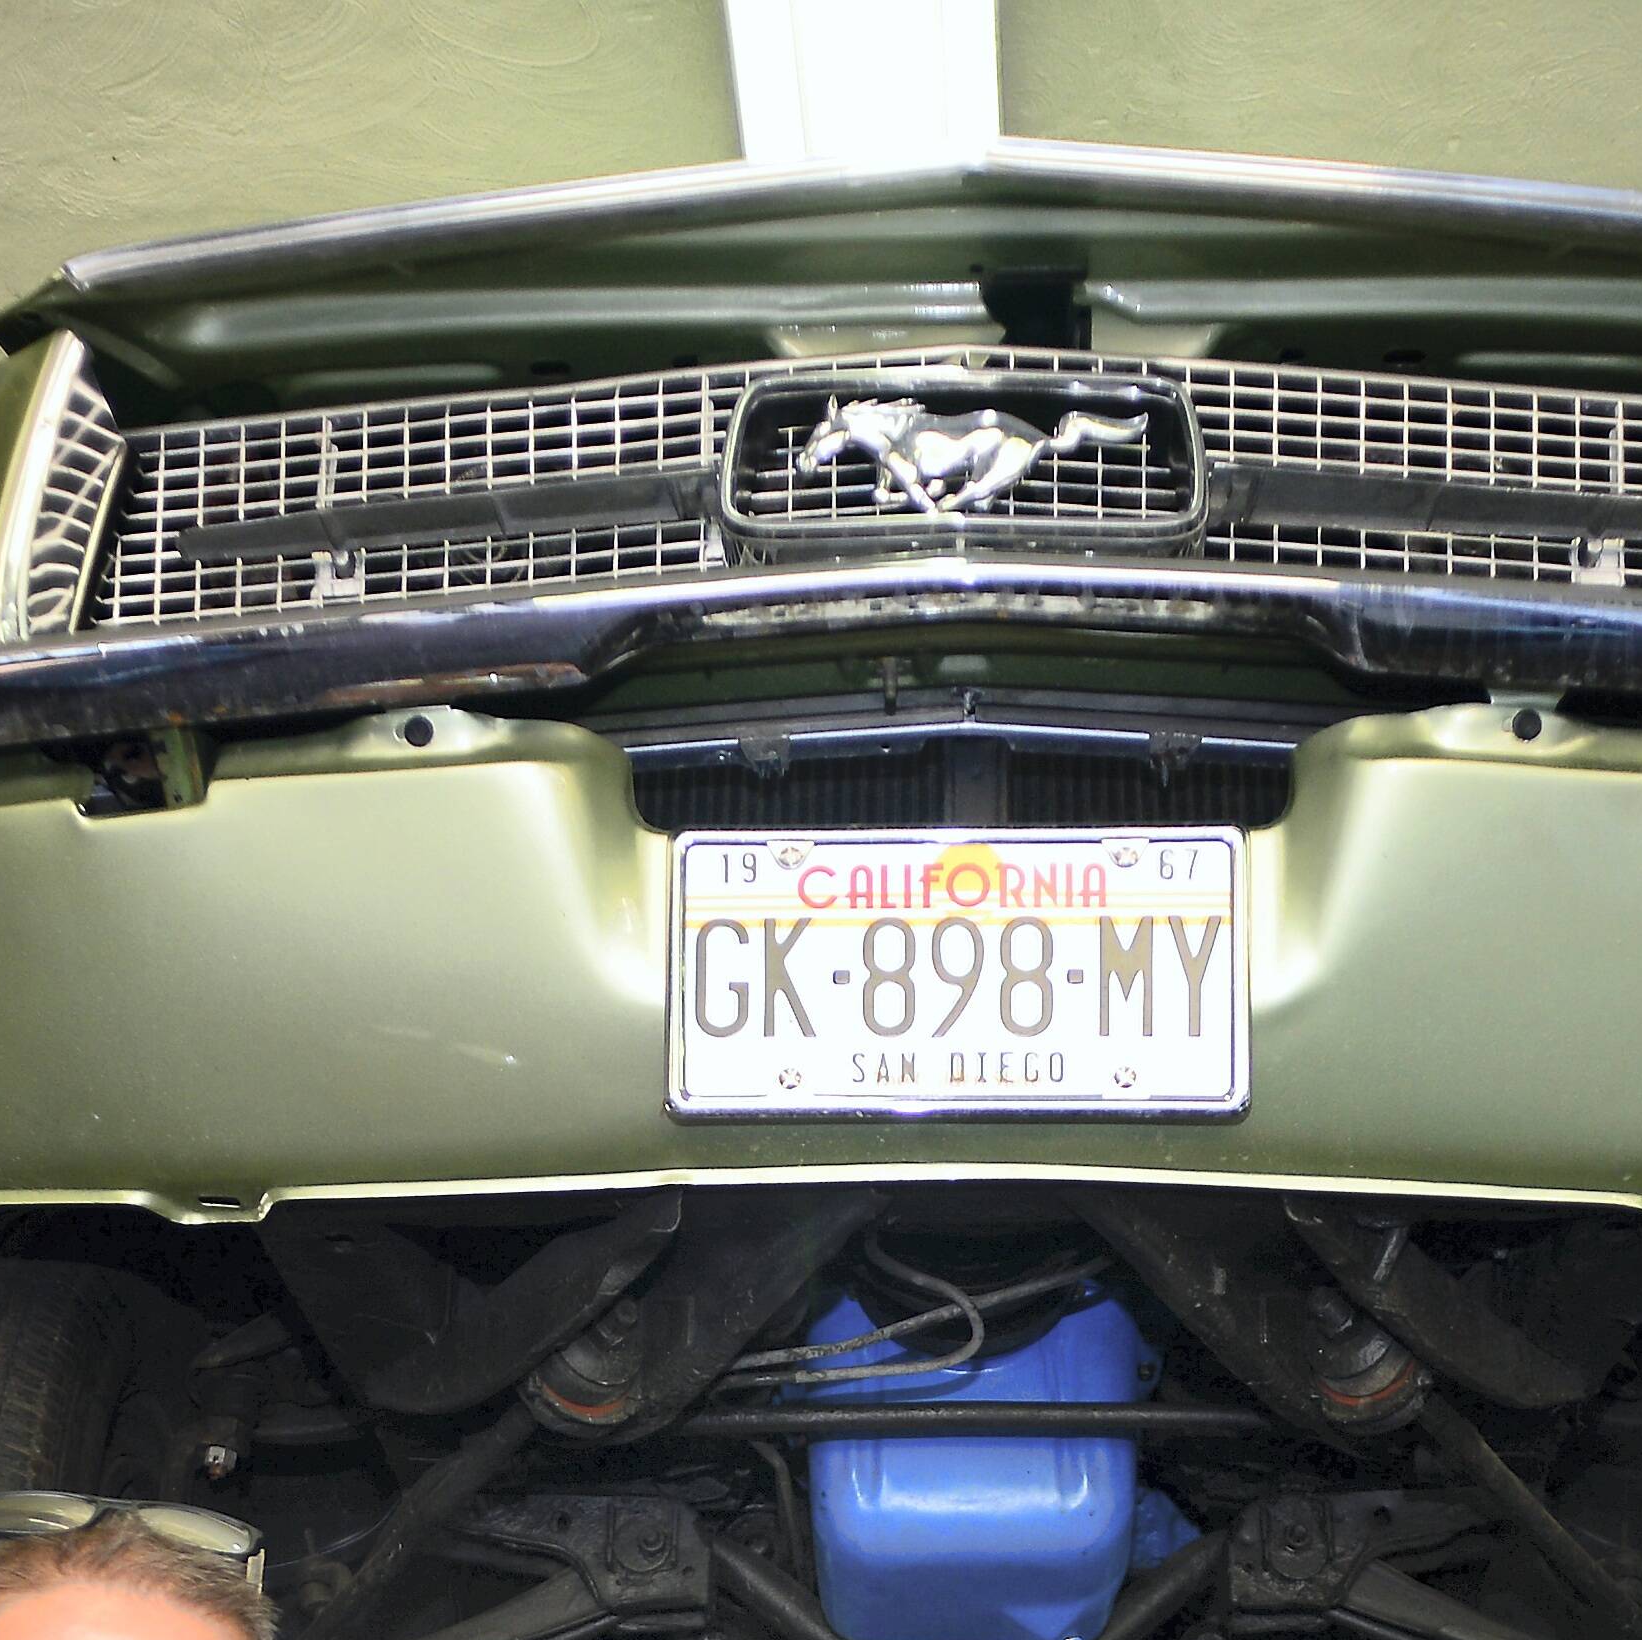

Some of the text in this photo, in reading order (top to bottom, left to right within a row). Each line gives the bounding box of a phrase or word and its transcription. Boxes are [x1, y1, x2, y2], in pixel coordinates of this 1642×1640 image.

[721, 848, 1199, 909] 19 CALIFORNIA 67
[694, 916, 1222, 1038] GK-898-MY
[851, 1051, 1065, 1083] SAN DIEGO
